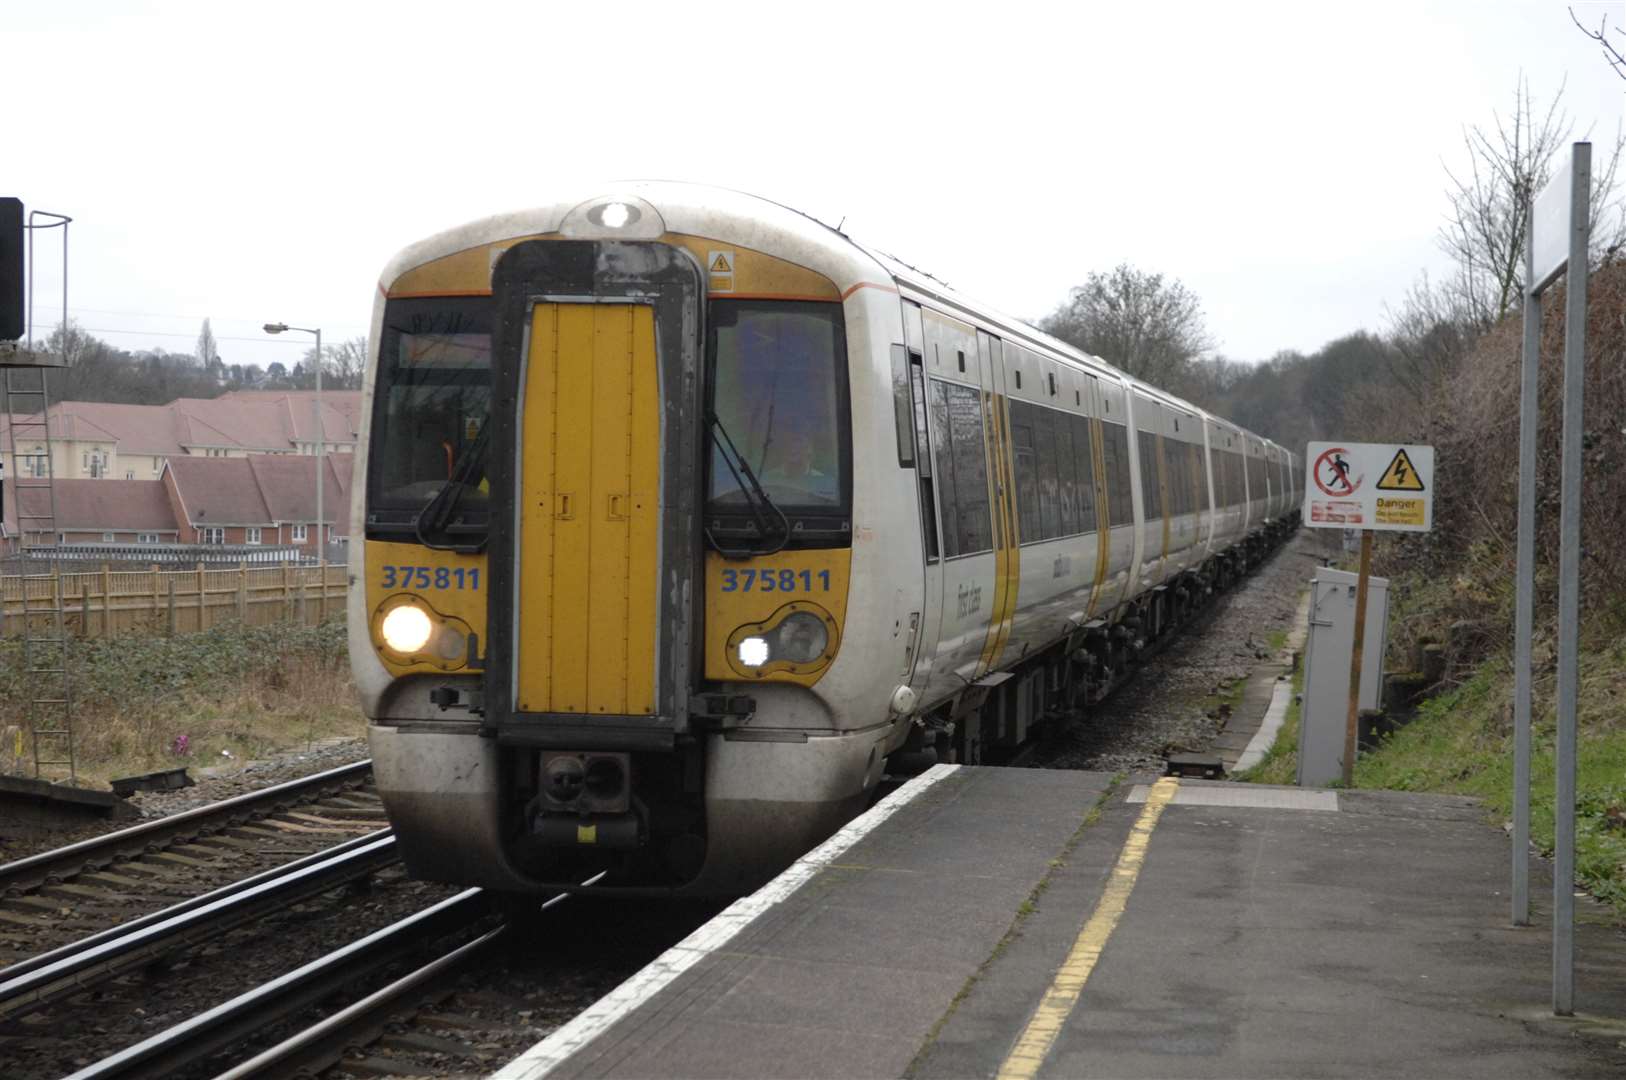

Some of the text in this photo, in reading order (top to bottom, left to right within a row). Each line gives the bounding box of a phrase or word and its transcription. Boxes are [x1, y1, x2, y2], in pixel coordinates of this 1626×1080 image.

[1376, 498, 1416, 509] Danger
[382, 565, 480, 591] 375811
[721, 568, 831, 593] 375811
